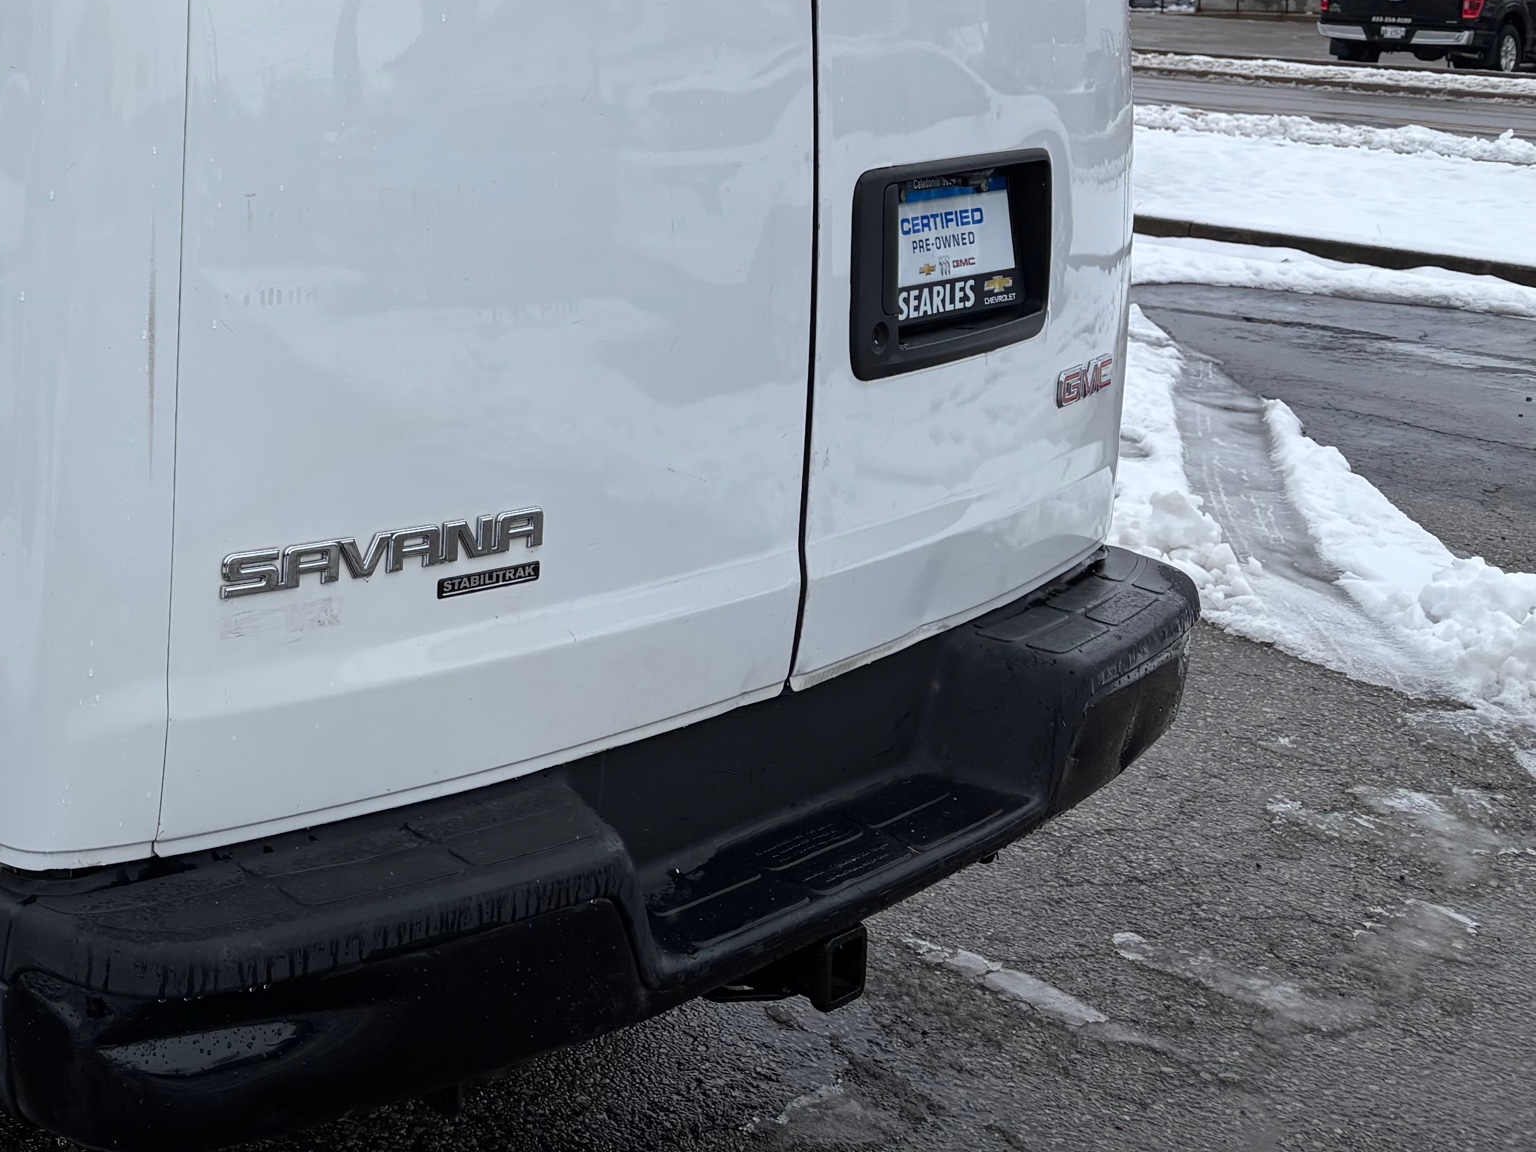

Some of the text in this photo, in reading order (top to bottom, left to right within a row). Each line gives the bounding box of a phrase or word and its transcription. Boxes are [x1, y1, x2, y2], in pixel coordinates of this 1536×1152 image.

[900, 207, 984, 235] CERTIFIED
[912, 232, 976, 254] PRE-OWNED
[952, 257, 976, 268] GMC
[898, 279, 975, 321] SEARLES
[984, 293, 1016, 305] CHEVROLET
[1056, 353, 1112, 408] GMC
[219, 505, 544, 599] SAVANA
[442, 564, 537, 594] STABILITRAK
